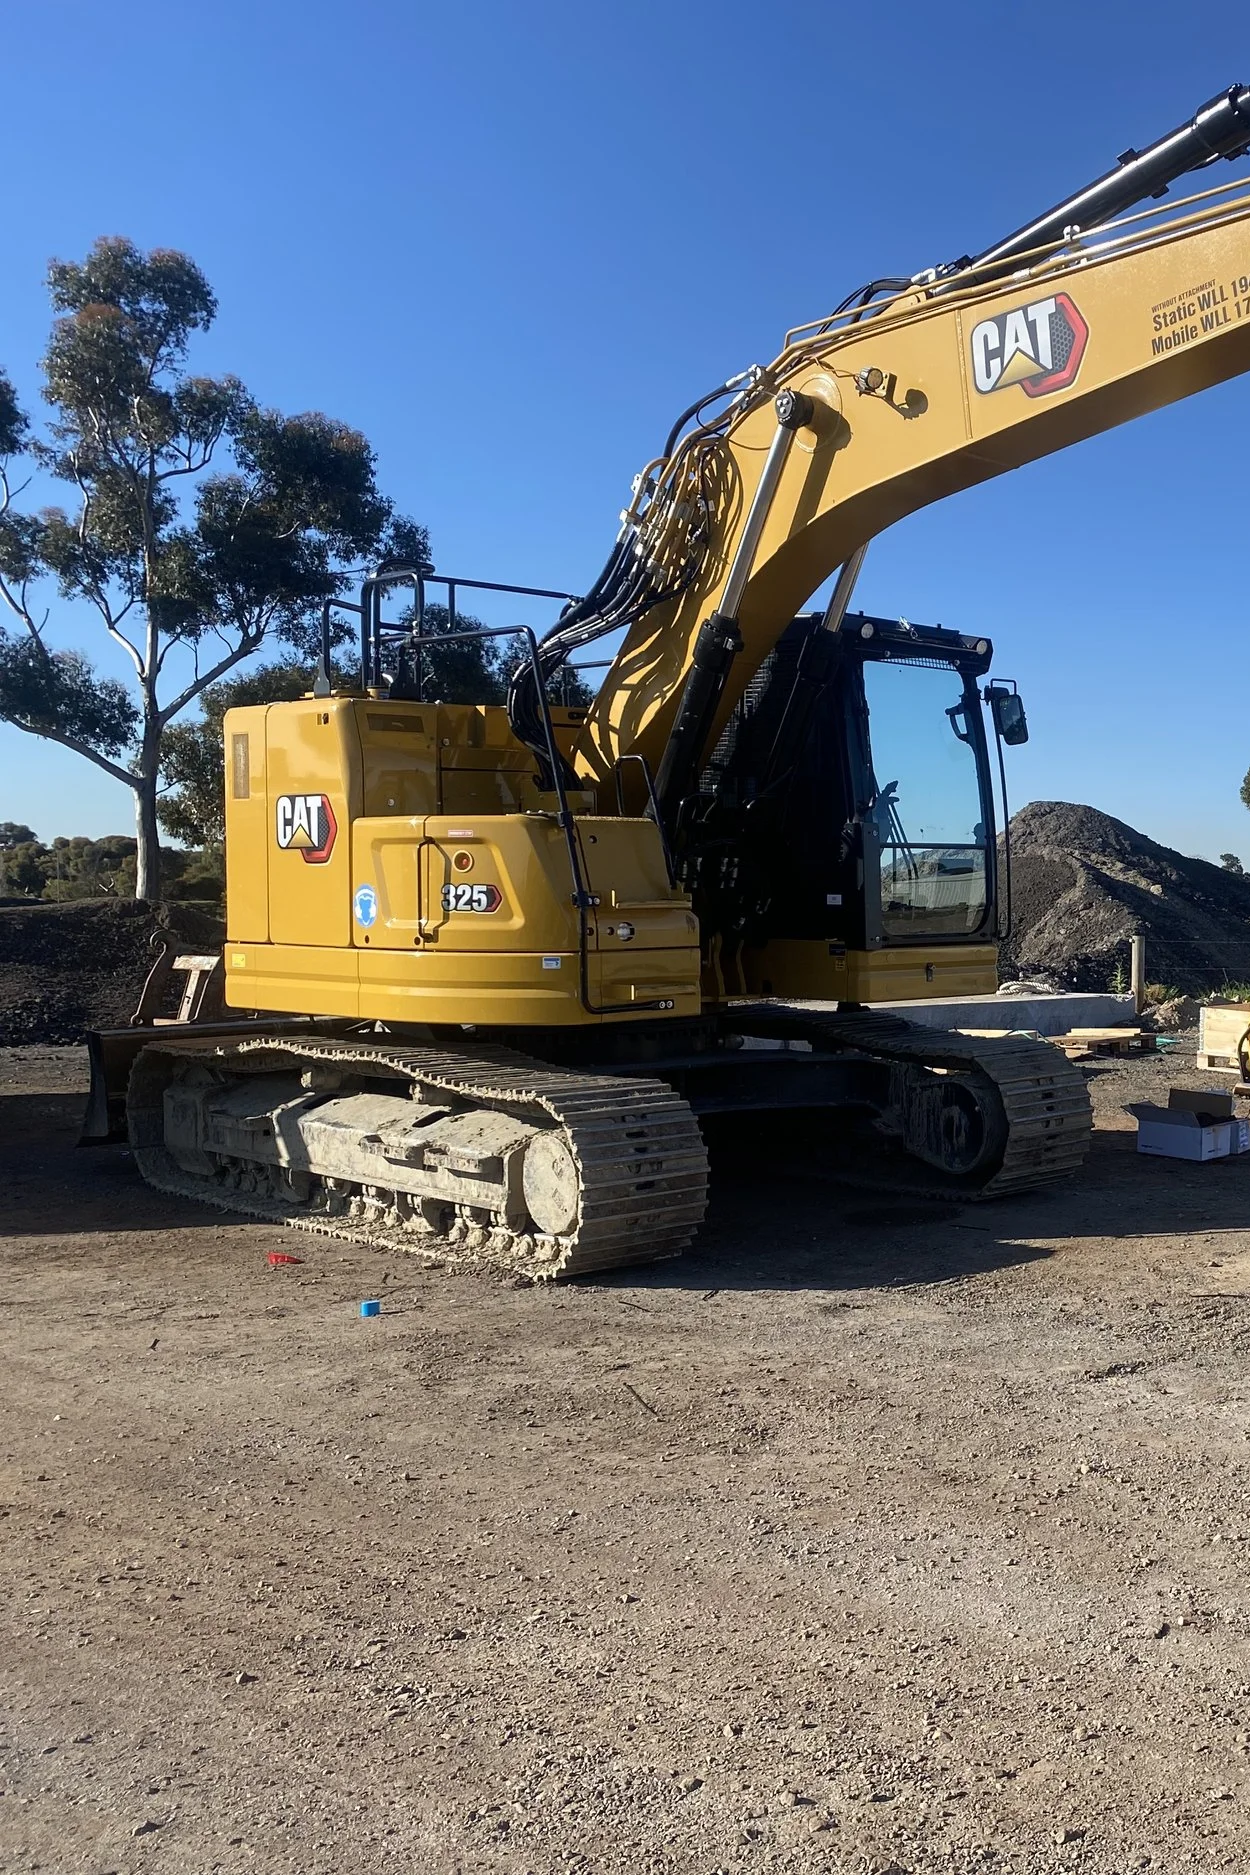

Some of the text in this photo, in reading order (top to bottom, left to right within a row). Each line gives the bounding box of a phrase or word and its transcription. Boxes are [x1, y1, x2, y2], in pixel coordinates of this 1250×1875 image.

[1151, 278, 1216, 314] WITHOUT ATTACHMENT
[1152, 301, 1196, 332] Static
[1197, 285, 1229, 312] WLL
[972, 297, 1056, 392] CAT
[1151, 324, 1199, 356] Mobile
[1200, 306, 1232, 333] WLL
[276, 796, 322, 849] CAT
[441, 883, 488, 912] 325
